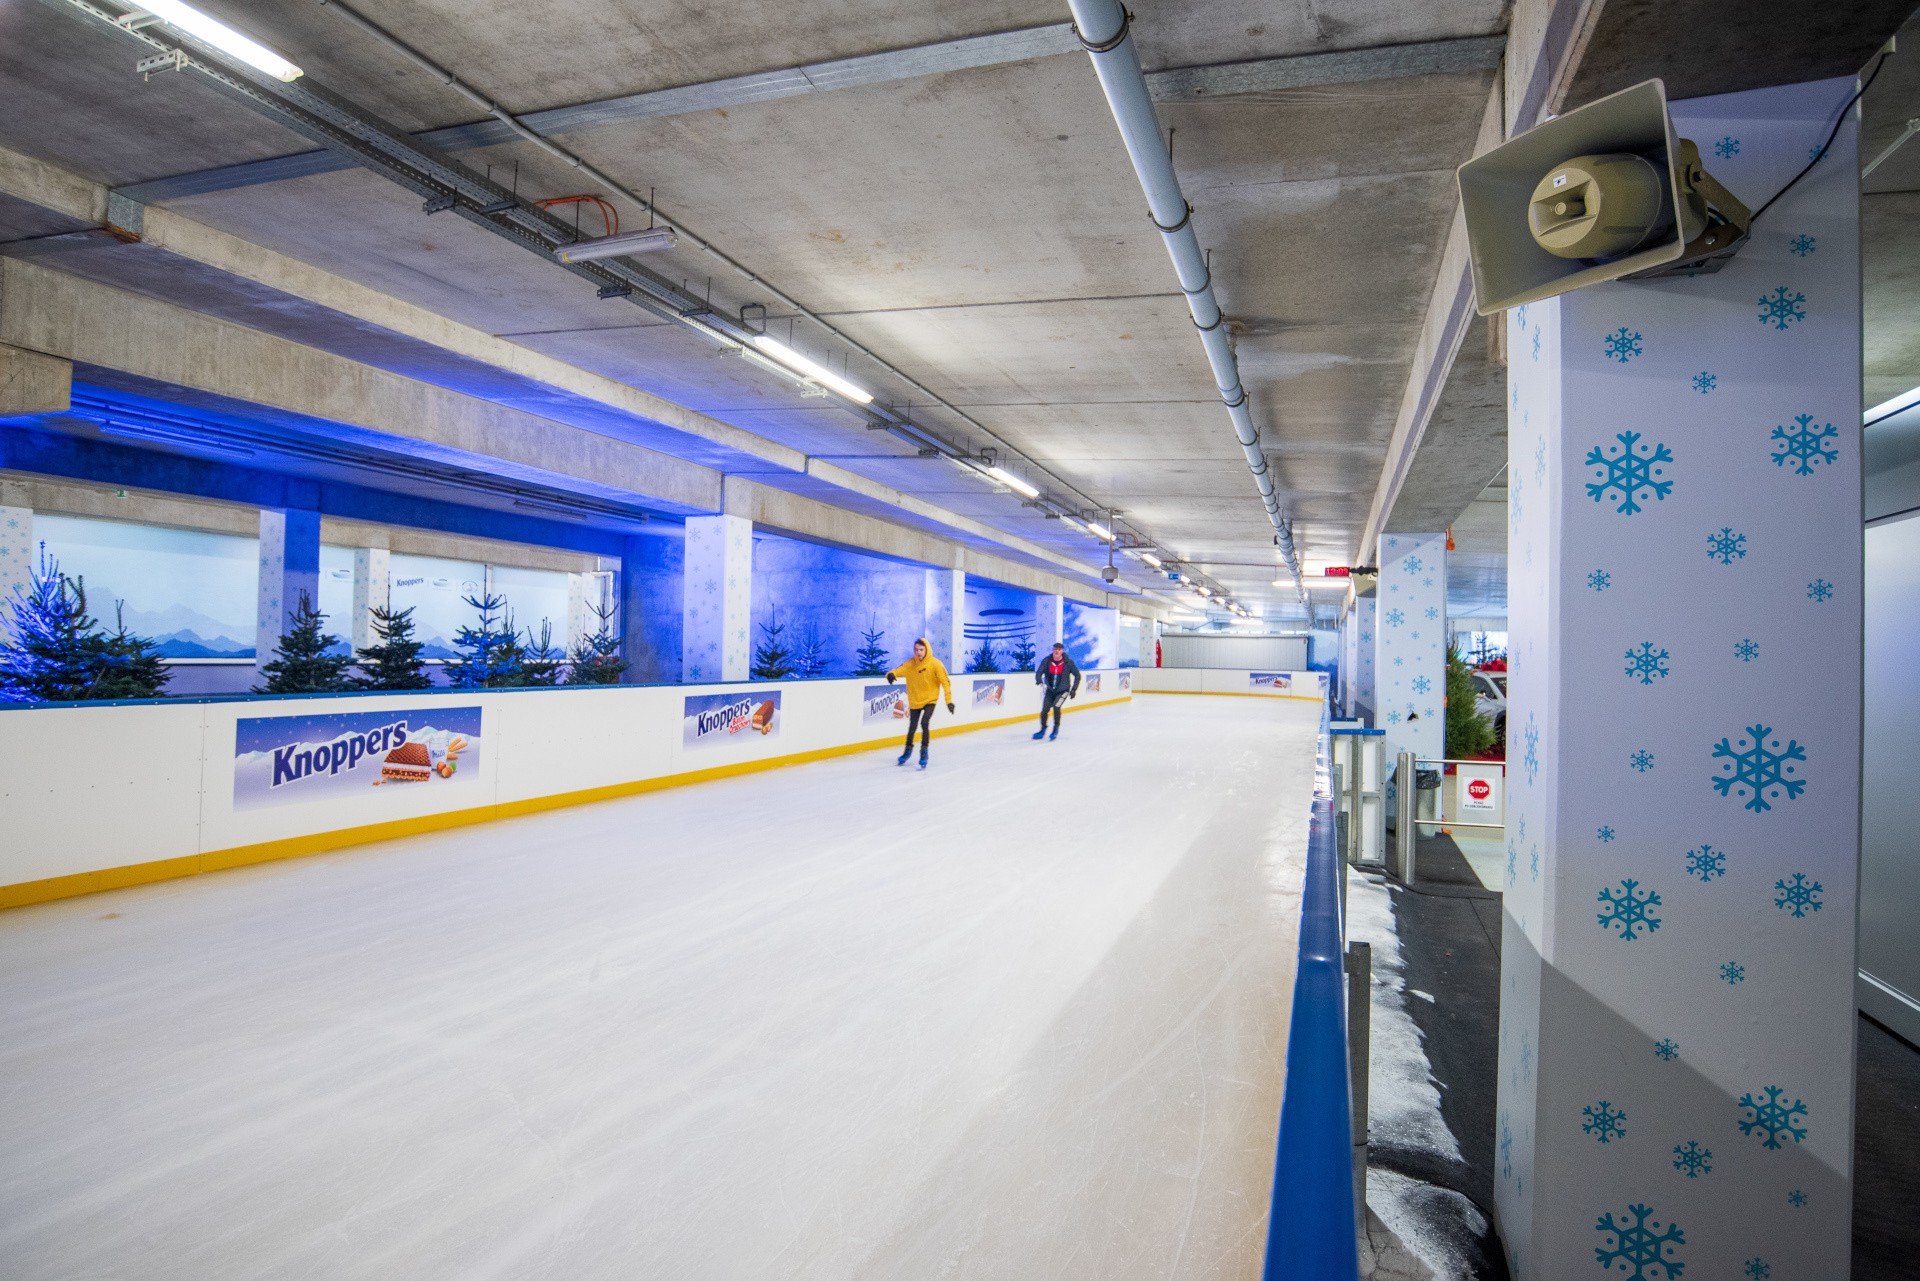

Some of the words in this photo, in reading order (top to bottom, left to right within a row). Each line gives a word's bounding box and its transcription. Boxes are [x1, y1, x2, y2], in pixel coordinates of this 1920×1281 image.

[396, 577, 424, 587] Knoppers
[870, 689, 901, 717] Knoppers
[697, 699, 751, 737] Knoppers
[271, 720, 408, 788] Knoppers
[1470, 785, 1489, 793] STOP
